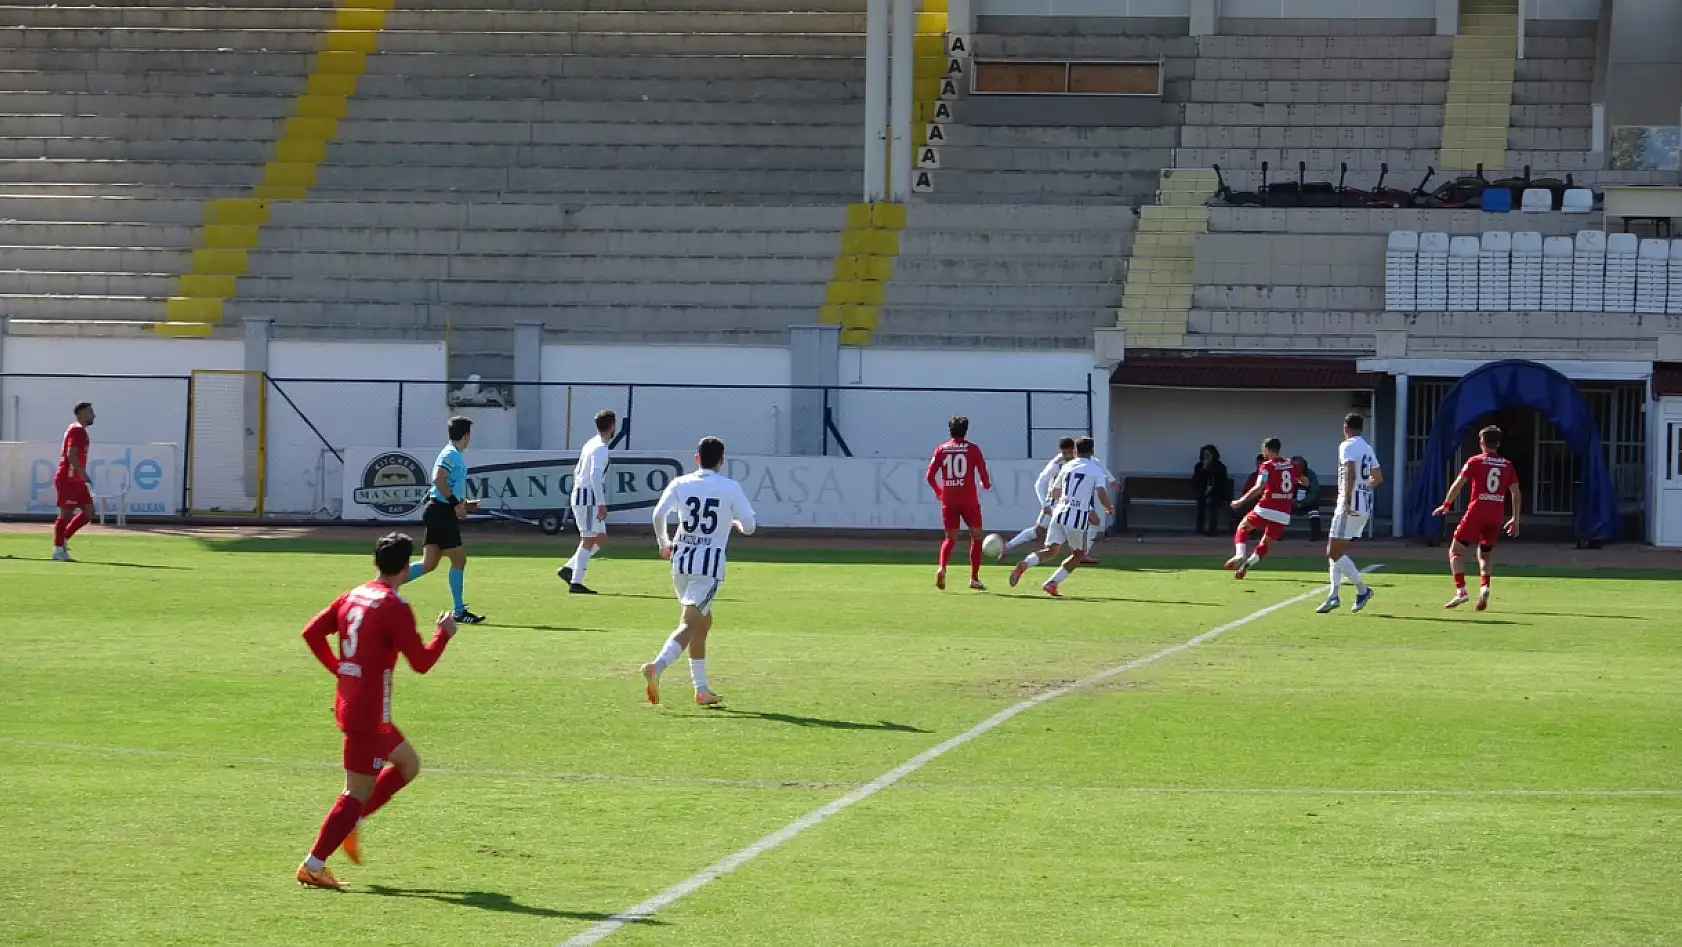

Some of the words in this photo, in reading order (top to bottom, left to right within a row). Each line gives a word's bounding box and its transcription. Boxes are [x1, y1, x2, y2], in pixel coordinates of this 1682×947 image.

[951, 37, 965, 52] A
[948, 59, 962, 73] A
[942, 80, 956, 95] A
[936, 103, 950, 118] A
[929, 125, 943, 140] A
[921, 148, 936, 164] A
[916, 171, 931, 187] A
[31, 448, 163, 499] prde
[943, 454, 967, 479] 10
[465, 469, 668, 498] MANCRO
[727, 458, 845, 515] PAŞA
[1064, 472, 1085, 498] 17
[1282, 470, 1293, 493] 8
[1486, 468, 1501, 493] 6
[360, 487, 430, 500] MANCER
[129, 503, 165, 513] KALKAN
[683, 496, 720, 534] 35
[342, 606, 365, 658] 3
